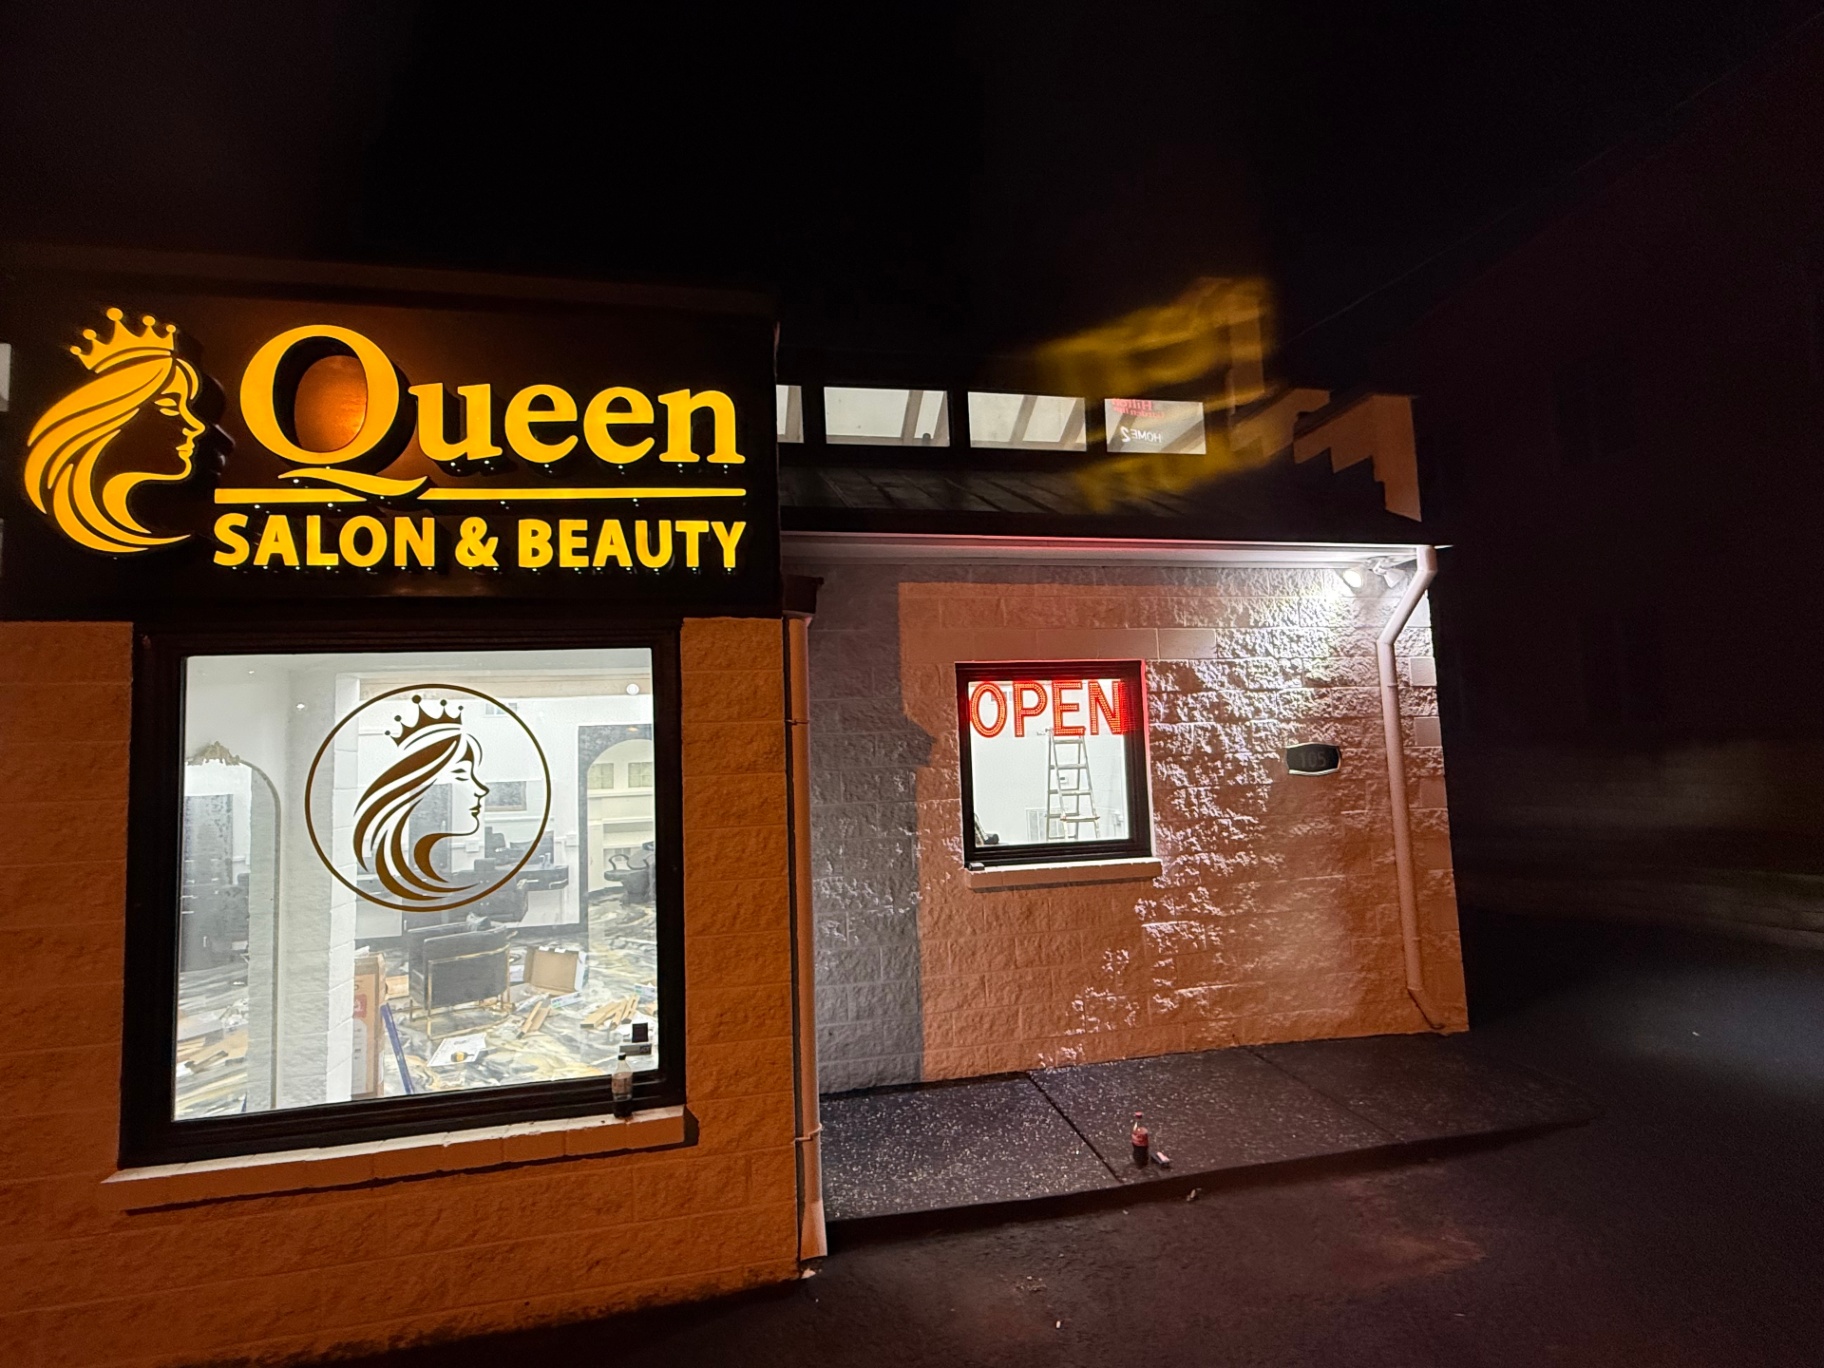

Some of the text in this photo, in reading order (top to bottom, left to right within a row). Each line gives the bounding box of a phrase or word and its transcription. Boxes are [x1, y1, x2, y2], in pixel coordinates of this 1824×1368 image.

[240, 324, 746, 496] Queen
[213, 512, 747, 569] SALON & BEAUTY
[969, 680, 1125, 739] OPEN
